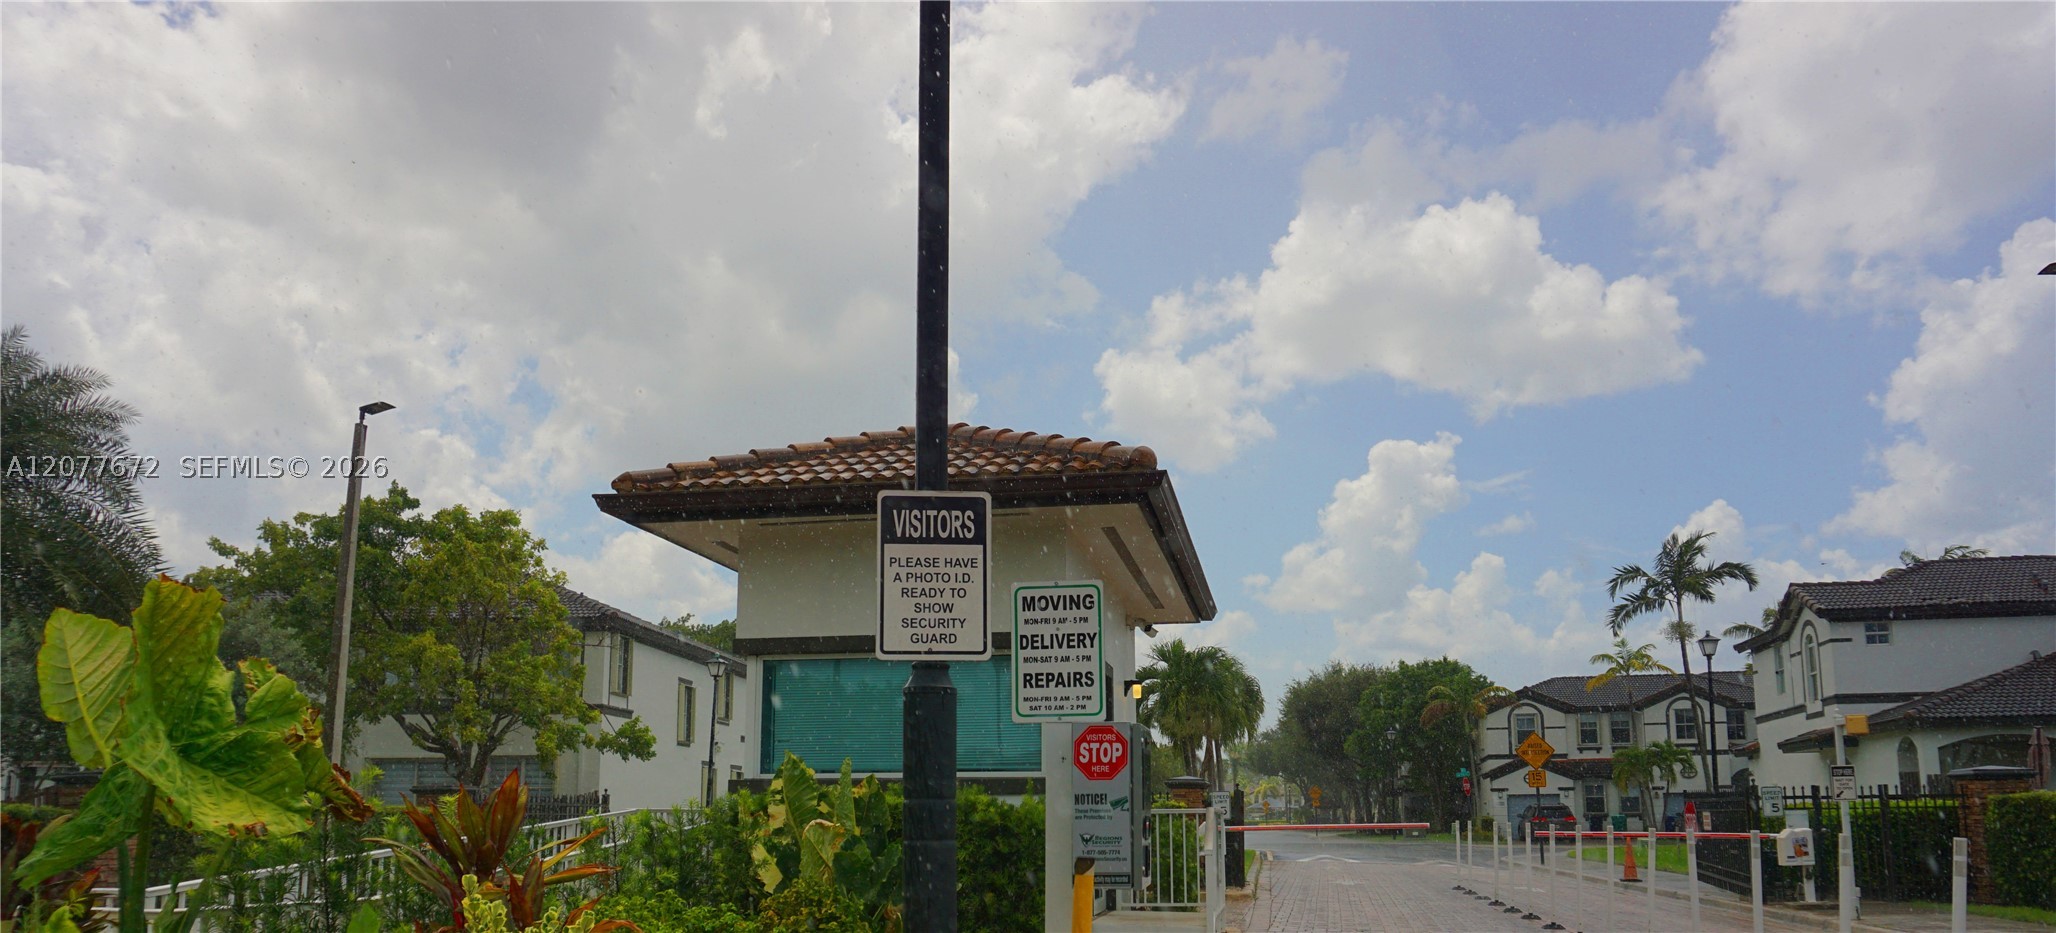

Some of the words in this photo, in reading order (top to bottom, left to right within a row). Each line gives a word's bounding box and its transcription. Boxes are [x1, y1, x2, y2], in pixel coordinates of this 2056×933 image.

[893, 509, 975, 539] VISITORS
[889, 557, 940, 568] PLEASE
[944, 558, 978, 569] HAVE
[893, 573, 902, 582] A
[906, 572, 950, 583] PHOTO
[954, 573, 974, 584] I.D.
[901, 588, 946, 598] READY
[949, 588, 966, 598] TO
[914, 603, 954, 614] SHOW
[1022, 594, 1094, 612] MOVING
[901, 618, 966, 629] SECURITY
[910, 633, 957, 644] GUARD
[1020, 632, 1097, 650] DELIVERY
[1023, 671, 1094, 688] REPAIRS
[1079, 742, 1122, 764] STOP
[1074, 794, 1107, 806] NOTICE!
[1772, 803, 1780, 812] 5
